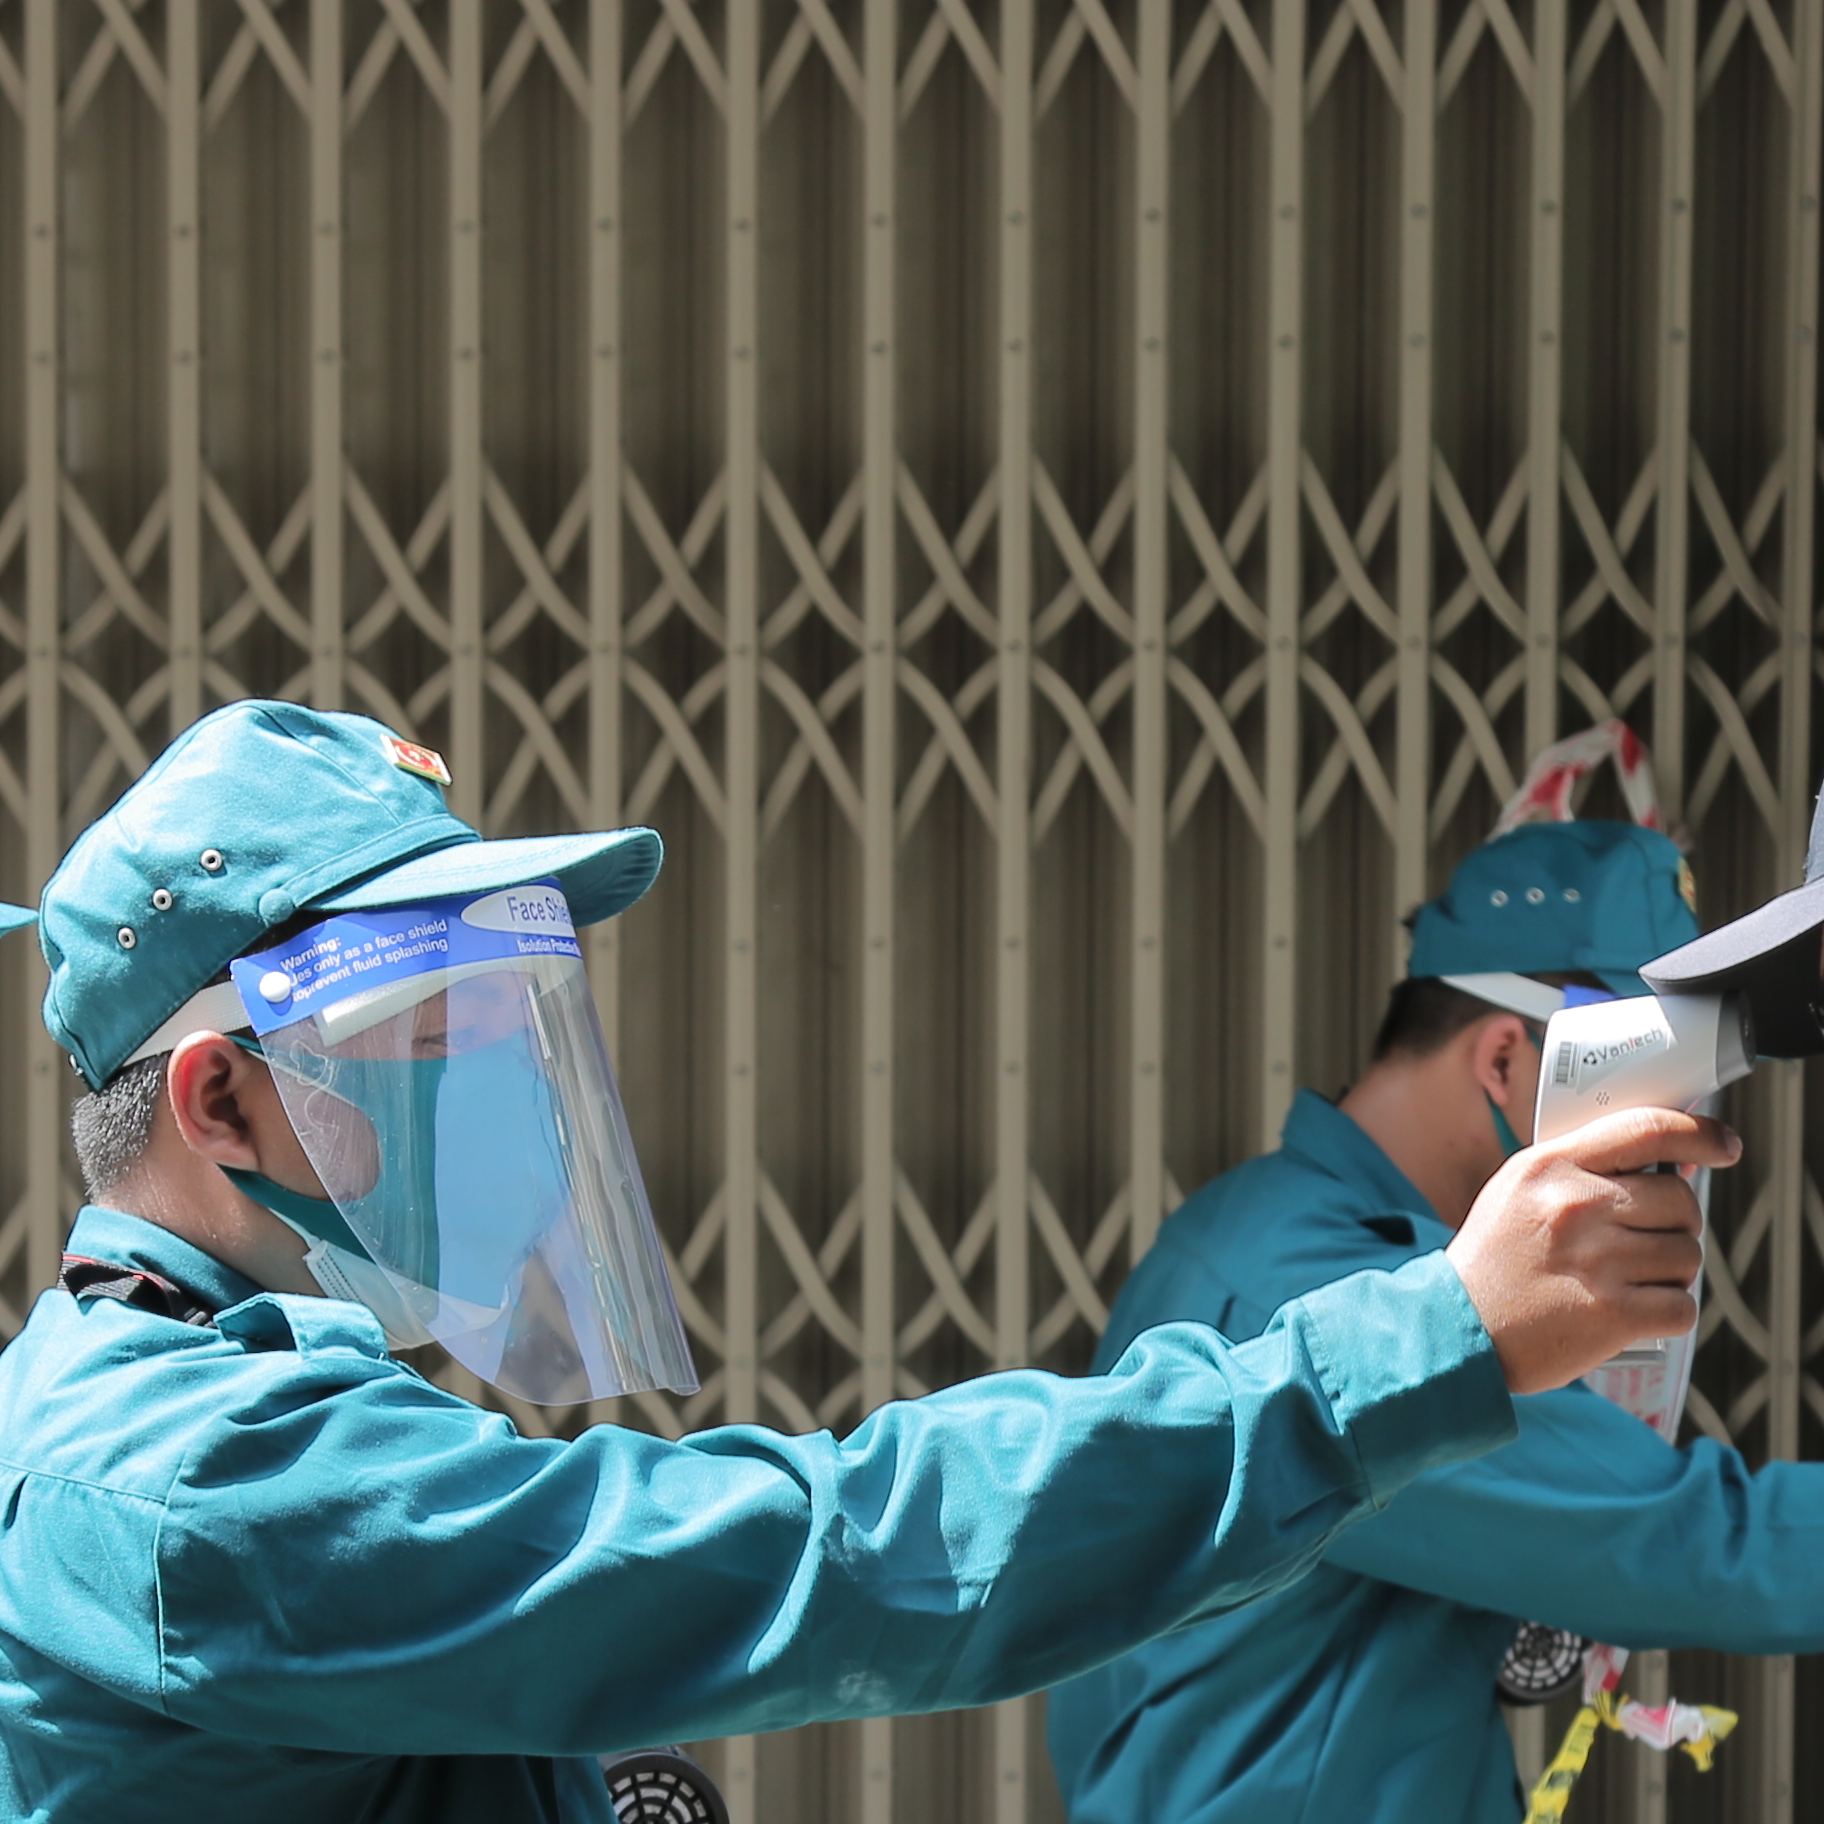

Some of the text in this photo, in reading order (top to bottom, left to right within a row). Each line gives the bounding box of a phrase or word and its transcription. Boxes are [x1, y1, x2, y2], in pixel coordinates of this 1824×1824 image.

[506, 896, 546, 921] Face
[280, 936, 342, 973] Warning:
[314, 954, 341, 977] only
[344, 944, 361, 960] as
[364, 942, 374, 954] a
[375, 932, 406, 949] face
[407, 919, 448, 940] shield
[352, 955, 382, 975] fluid
[384, 938, 448, 964] splashing
